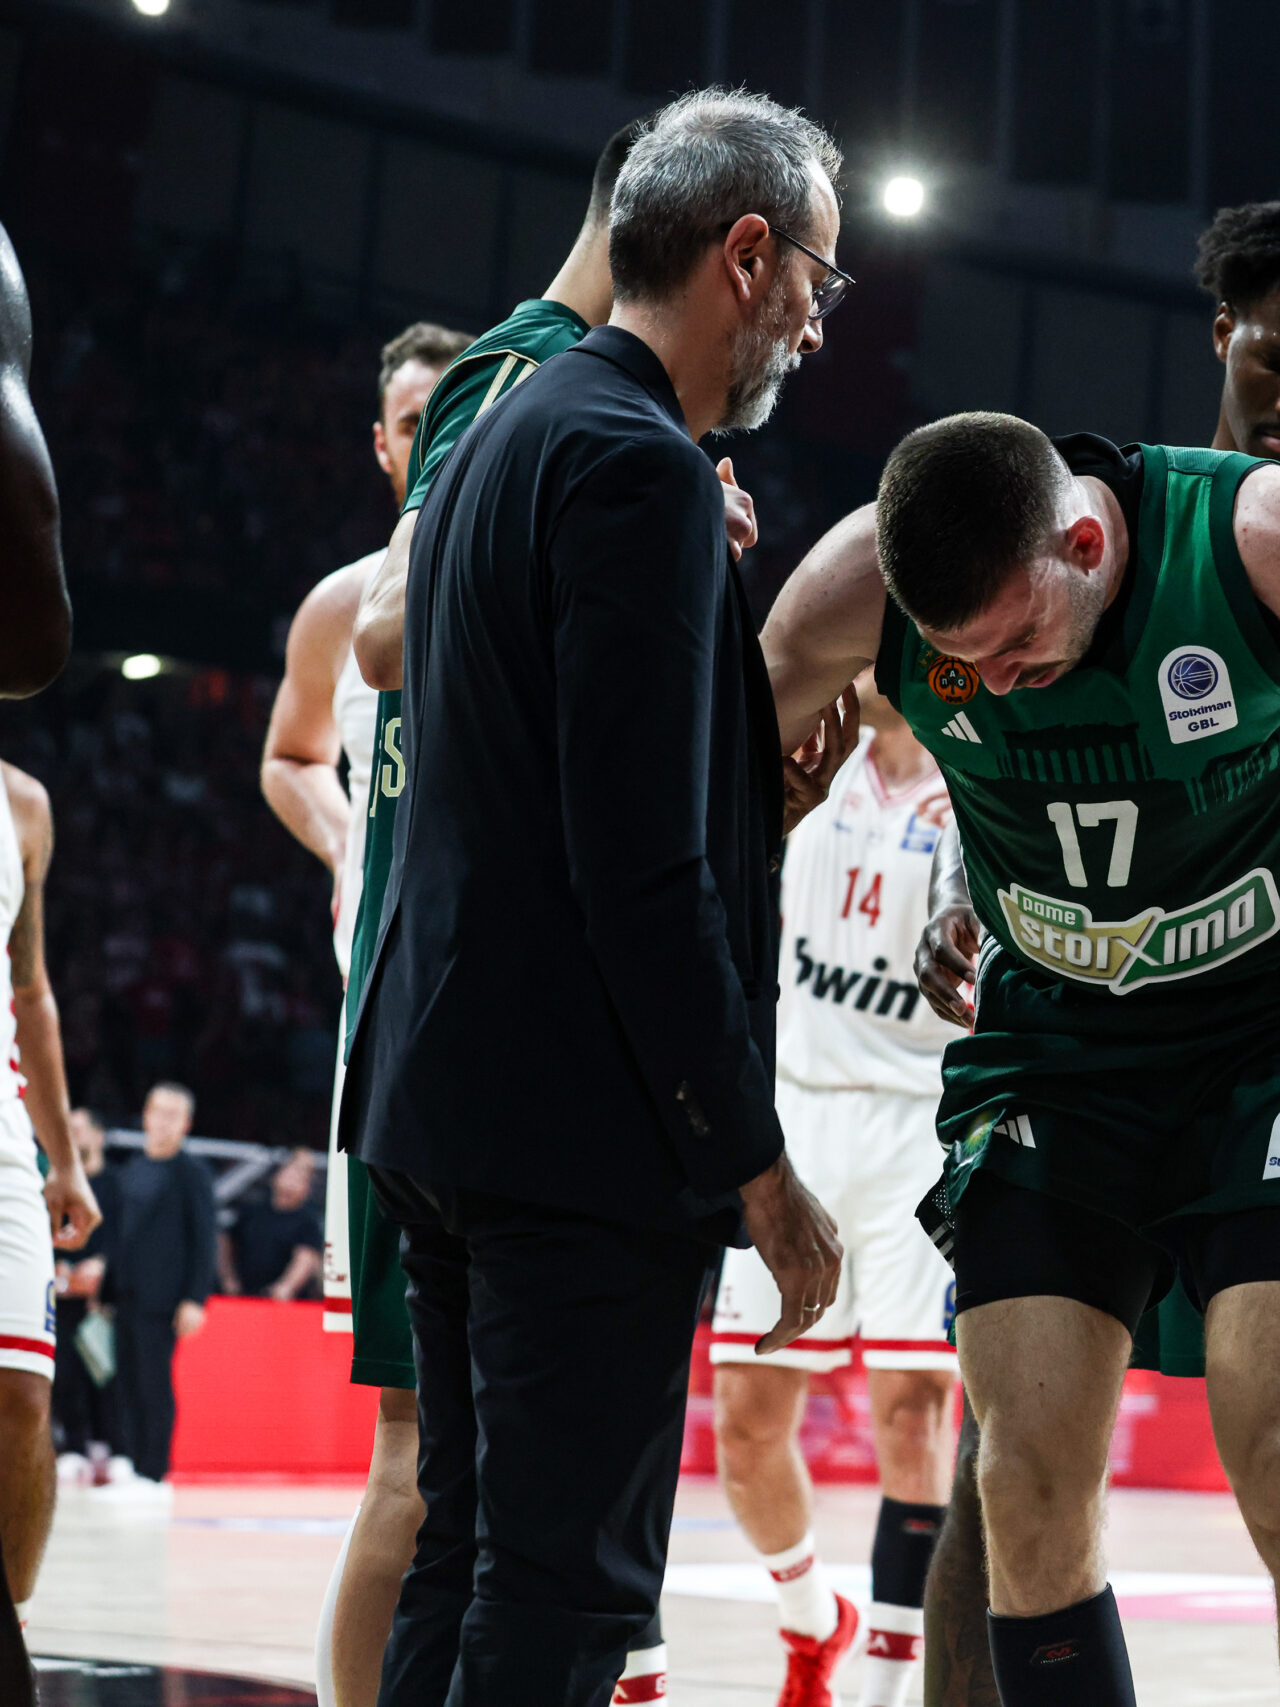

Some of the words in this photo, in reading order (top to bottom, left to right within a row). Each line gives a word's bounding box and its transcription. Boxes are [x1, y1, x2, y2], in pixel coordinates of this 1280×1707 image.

[1168, 700, 1232, 721] Stoiximan
[1187, 717, 1219, 732] GBL
[1046, 800, 1139, 888] 17
[841, 866, 882, 928] 14
[1021, 895, 1077, 926] pame
